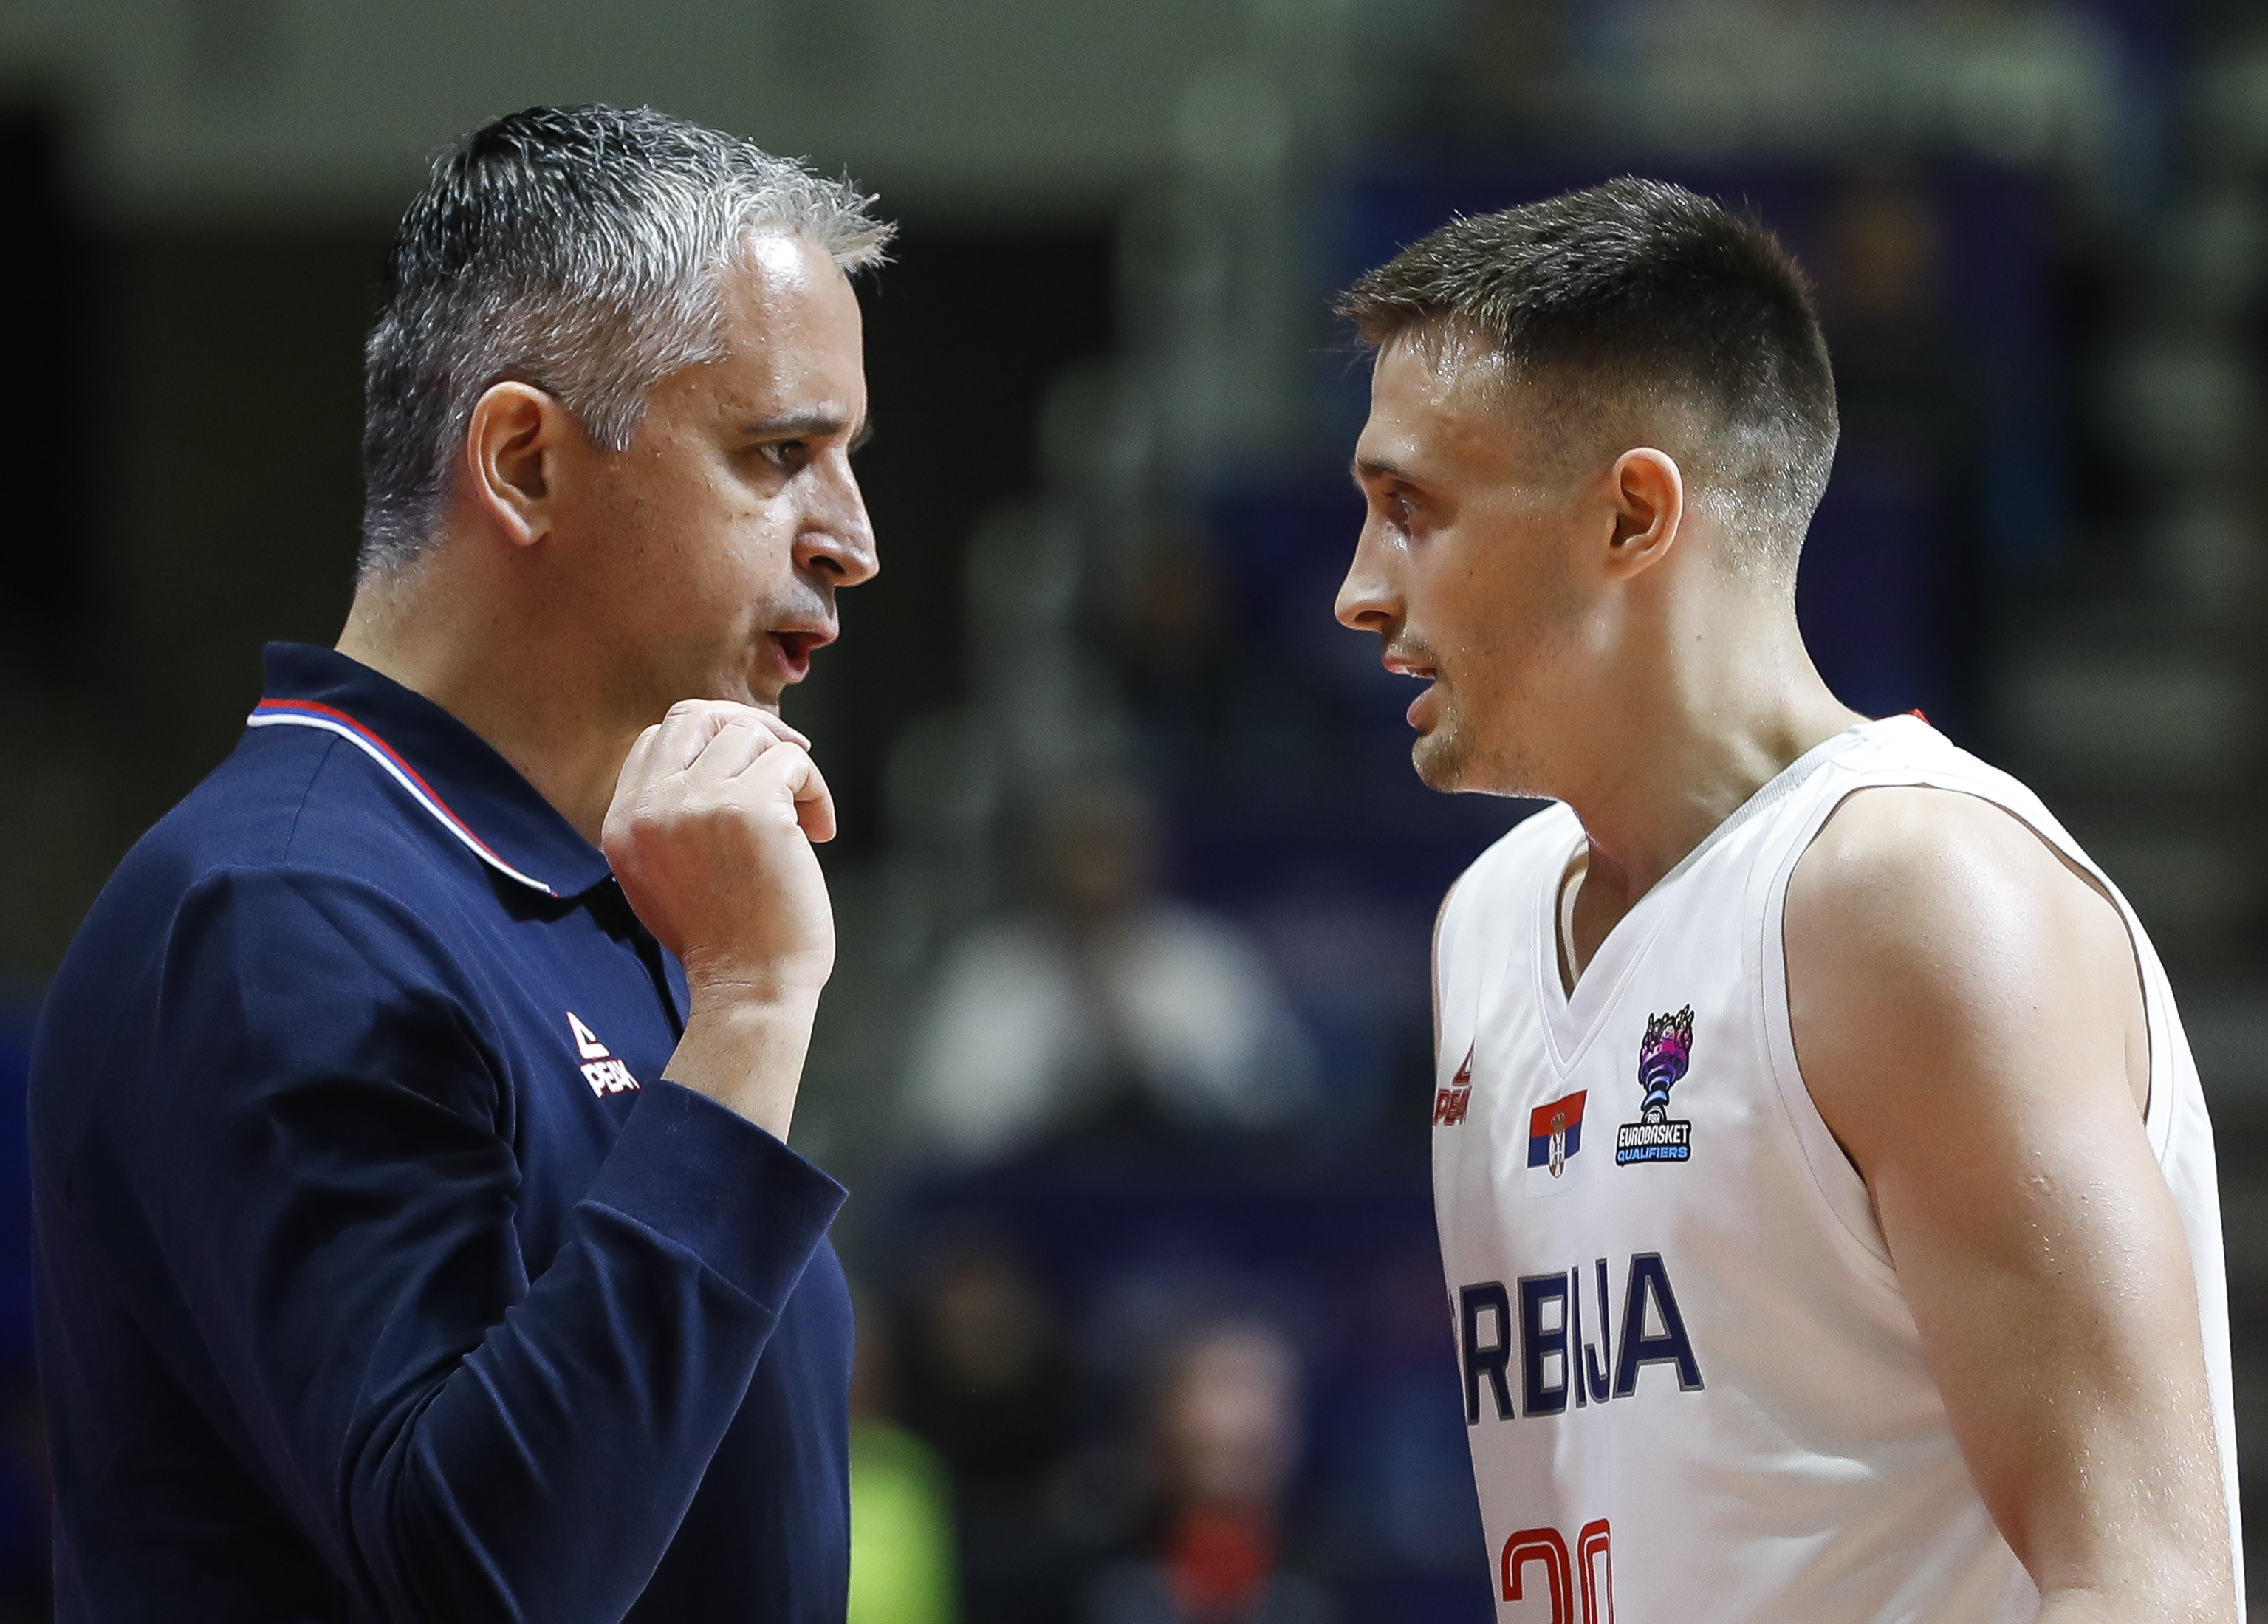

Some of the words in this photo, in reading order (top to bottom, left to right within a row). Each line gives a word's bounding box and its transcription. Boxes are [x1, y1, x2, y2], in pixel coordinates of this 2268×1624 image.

[1618, 1124, 1689, 1148] EUROBASKET
[1617, 1146, 1688, 1162] QUALIFIERS
[1449, 1251, 1706, 1427] RBIJA
